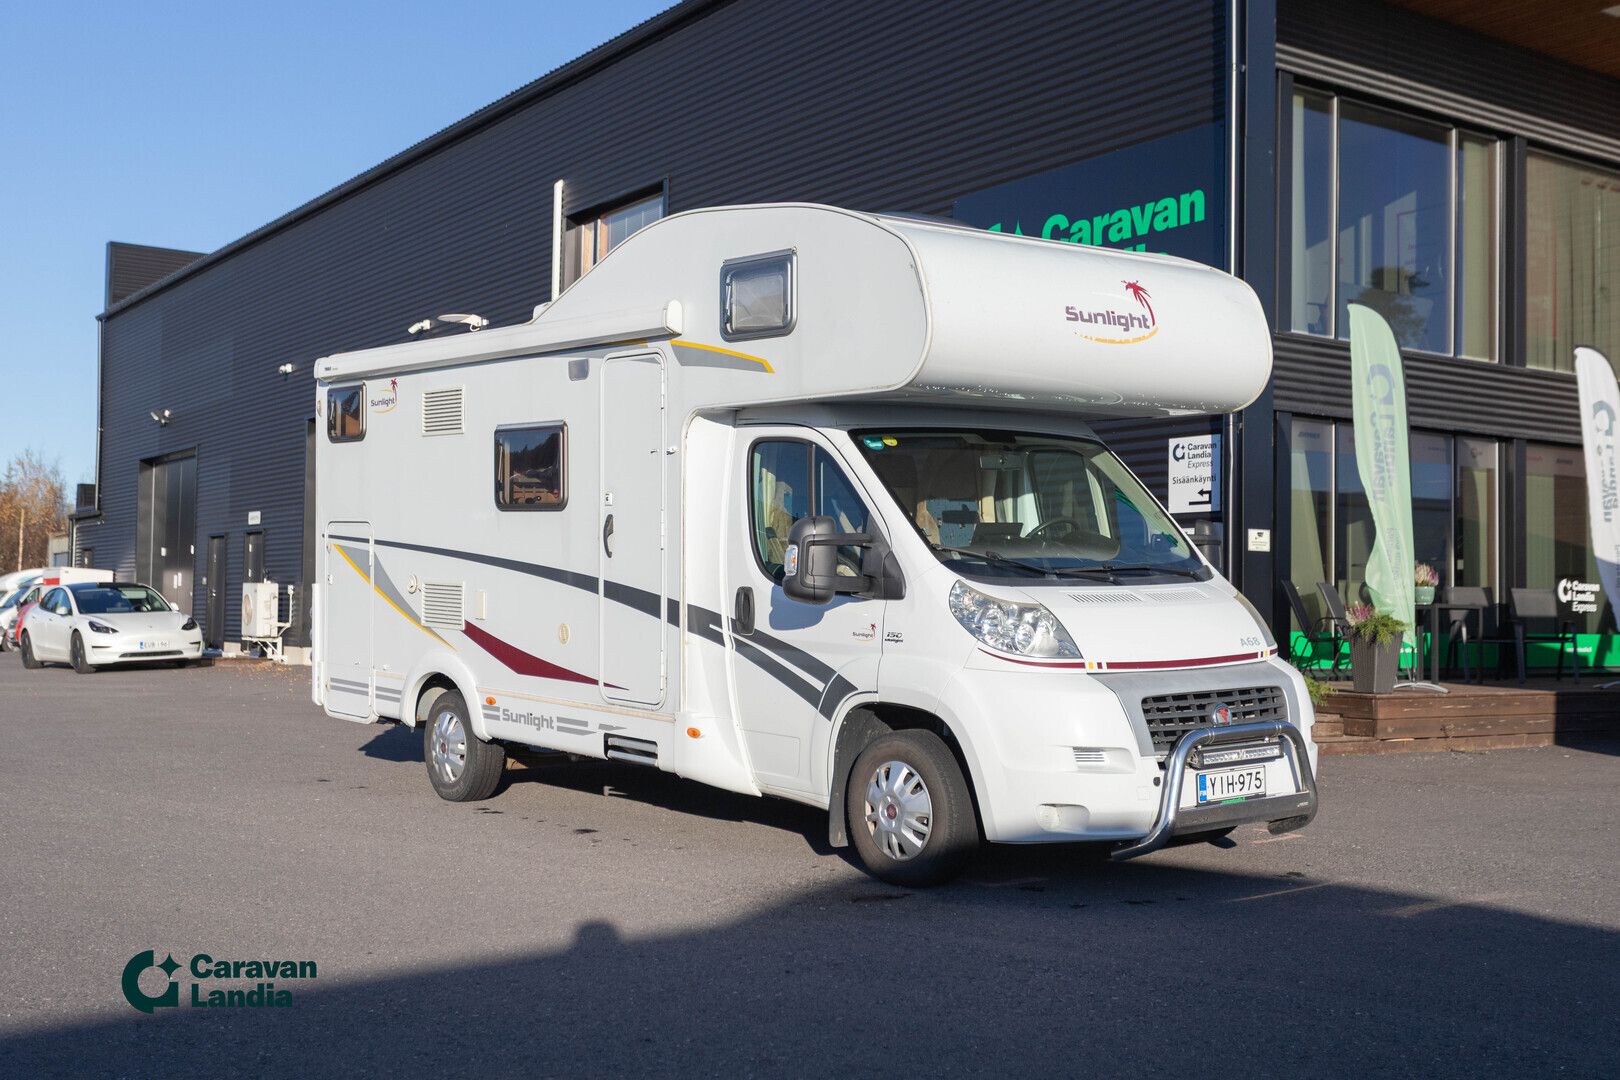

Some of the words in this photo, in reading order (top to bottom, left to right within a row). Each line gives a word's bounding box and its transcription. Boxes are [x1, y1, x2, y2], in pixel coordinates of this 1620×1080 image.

[1041, 189, 1205, 246] Caravan
[1065, 306, 1150, 332] Sunlight
[371, 397, 395, 407] Sunlight
[1187, 443, 1217, 451] Caravan
[1187, 451, 1212, 460] Landia
[1187, 460, 1214, 469] Express
[1172, 475, 1217, 485] Sisäänkäynti
[1240, 637, 1260, 646] A68
[502, 708, 554, 731] Sunlight
[1210, 771, 1262, 796] YIH-975
